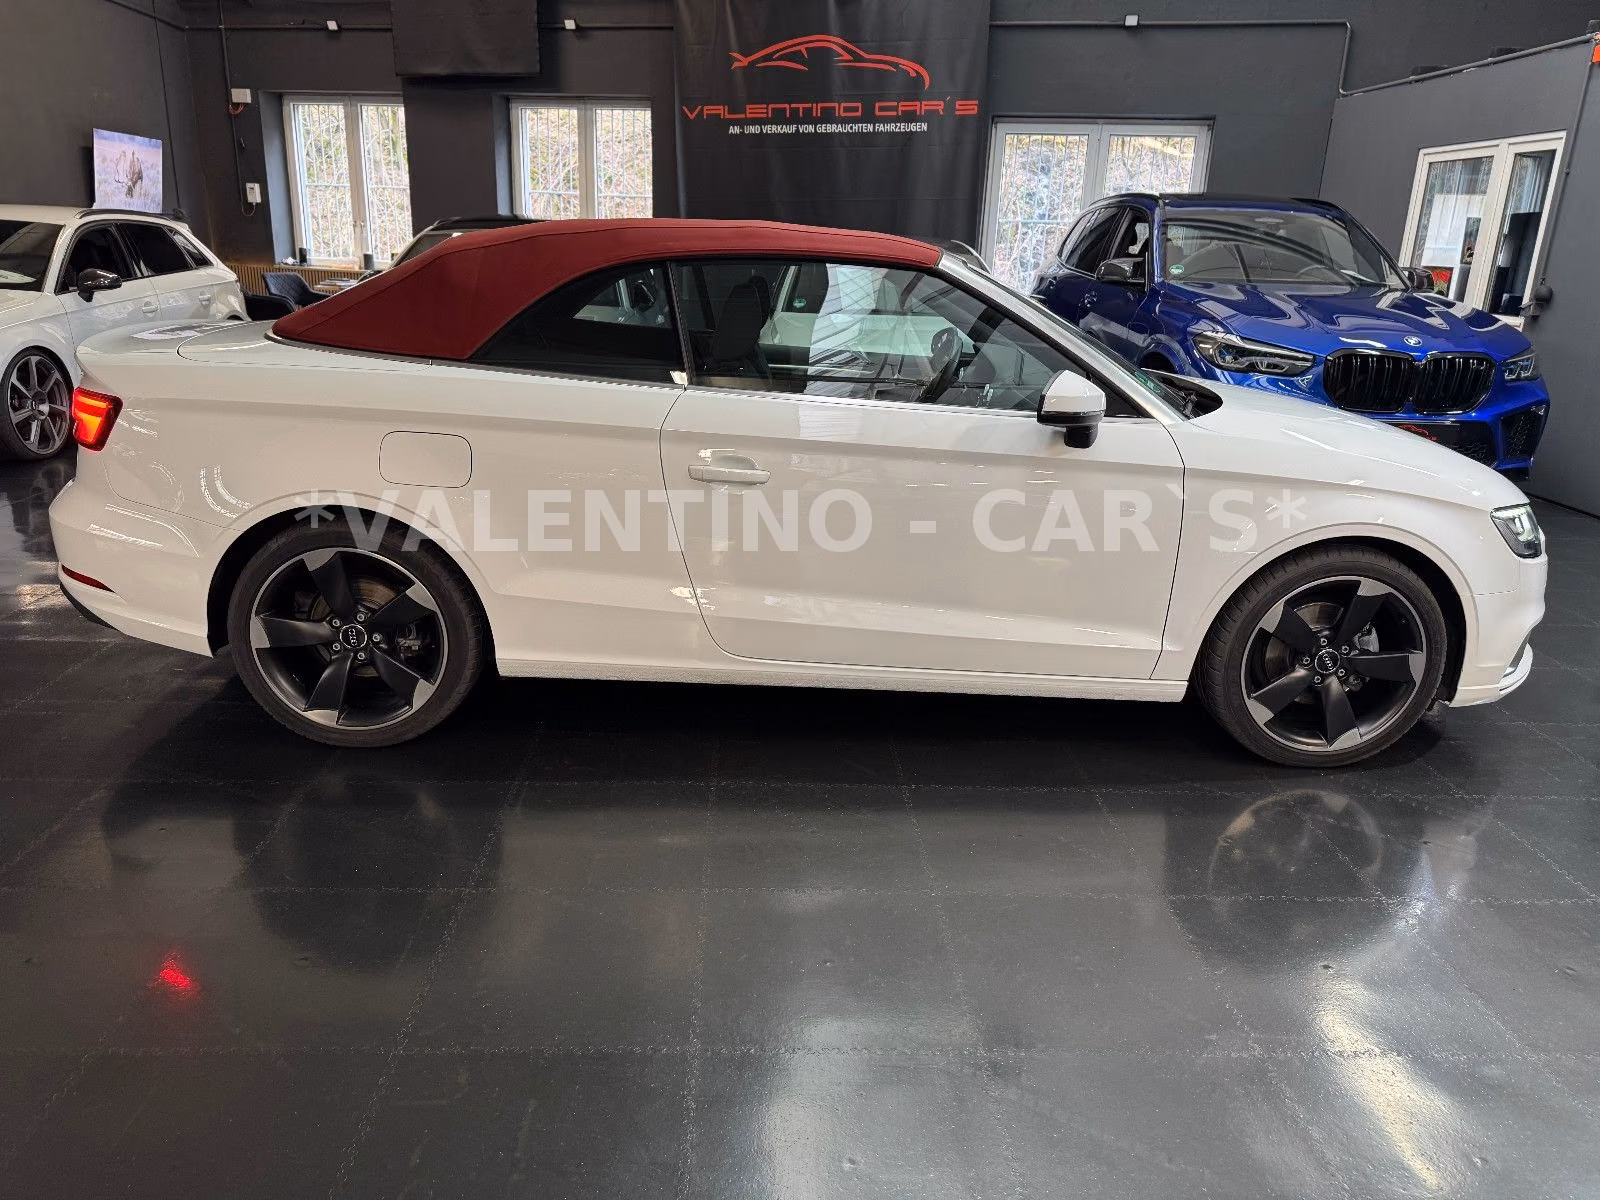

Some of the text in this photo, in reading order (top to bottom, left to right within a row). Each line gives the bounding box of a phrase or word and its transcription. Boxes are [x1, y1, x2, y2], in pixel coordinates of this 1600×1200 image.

[682, 102, 862, 120] VALENTINO
[728, 122, 928, 135] AN- UND VERKAUF VON GEBRAUCHTEN FAHRZEUGEN
